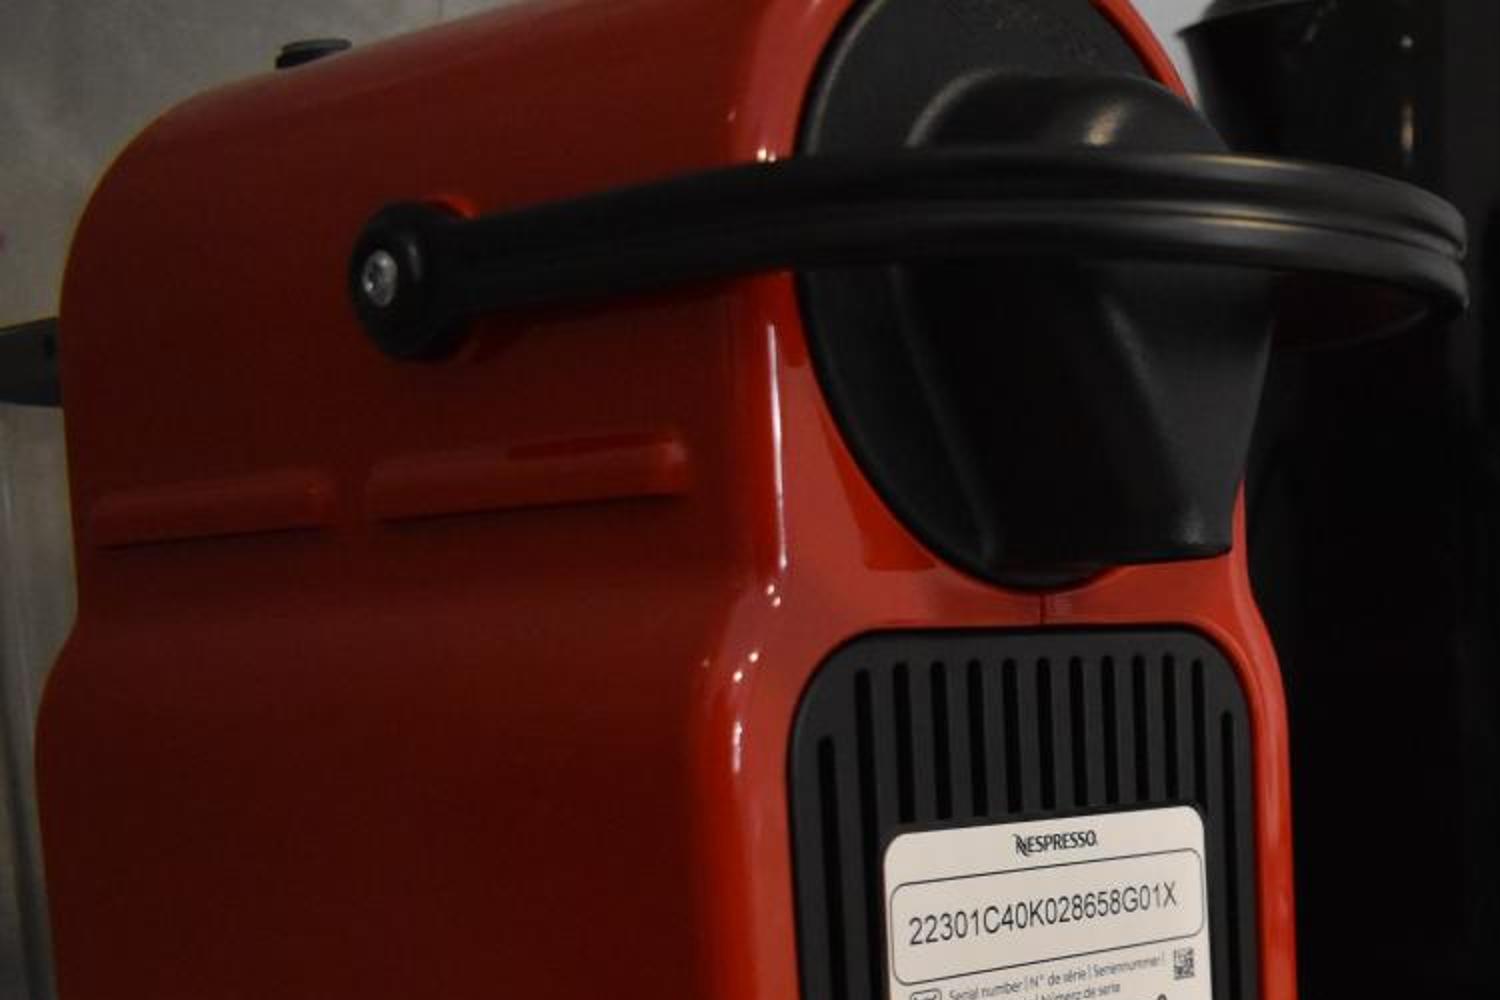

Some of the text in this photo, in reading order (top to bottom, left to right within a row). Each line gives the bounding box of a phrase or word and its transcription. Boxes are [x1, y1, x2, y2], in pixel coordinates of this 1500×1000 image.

[1013, 830, 1097, 856] NESPRESSO
[909, 881, 1177, 946] 22301C40K028658G01X
[981, 979, 1023, 997] number
[1047, 970, 1061, 987] de
